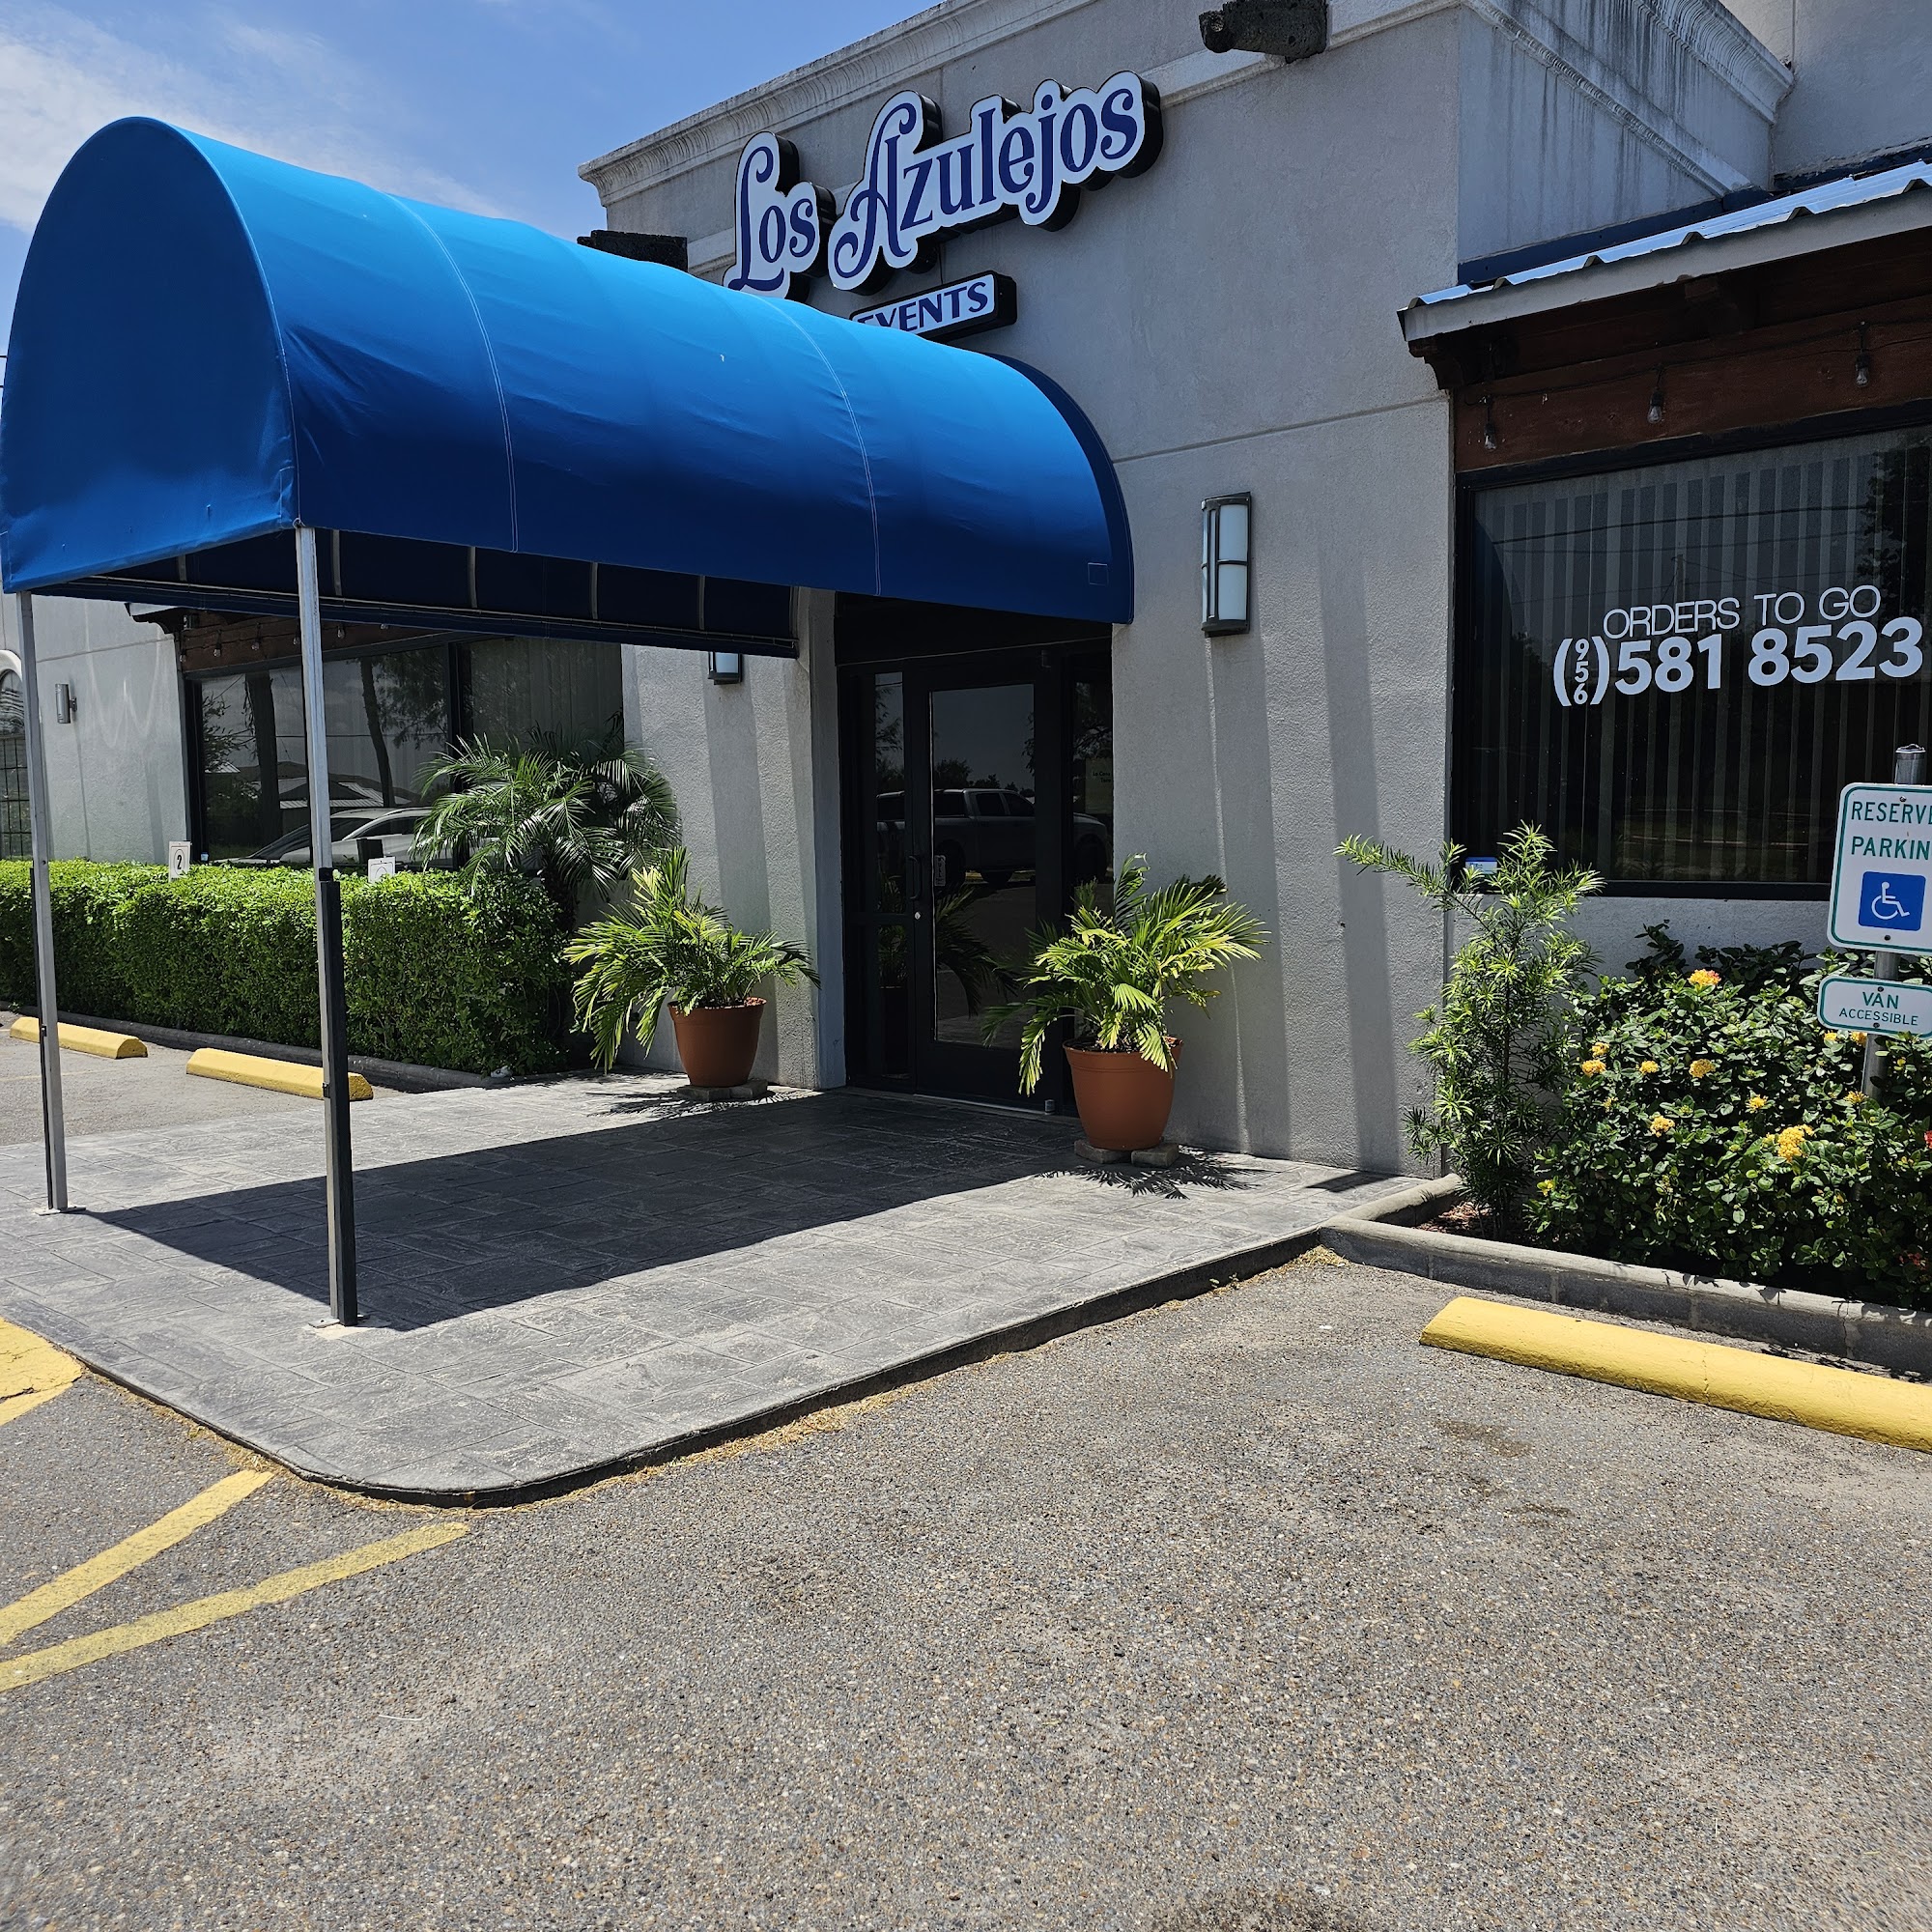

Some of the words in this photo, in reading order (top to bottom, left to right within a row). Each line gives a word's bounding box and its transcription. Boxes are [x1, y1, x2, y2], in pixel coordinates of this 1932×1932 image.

[727, 146, 816, 292] Los
[834, 87, 1135, 279] Azulejos
[857, 281, 988, 332] VENTS
[1603, 597, 1740, 639] ORDERS
[1753, 591, 1805, 626] TO
[1819, 584, 1881, 620] GO
[1747, 616, 1923, 687] 8523
[177, 854, 183, 870] 2
[1838, 1008, 1919, 1026] ACCESSIBLE
[1862, 991, 1899, 1009] VAN
